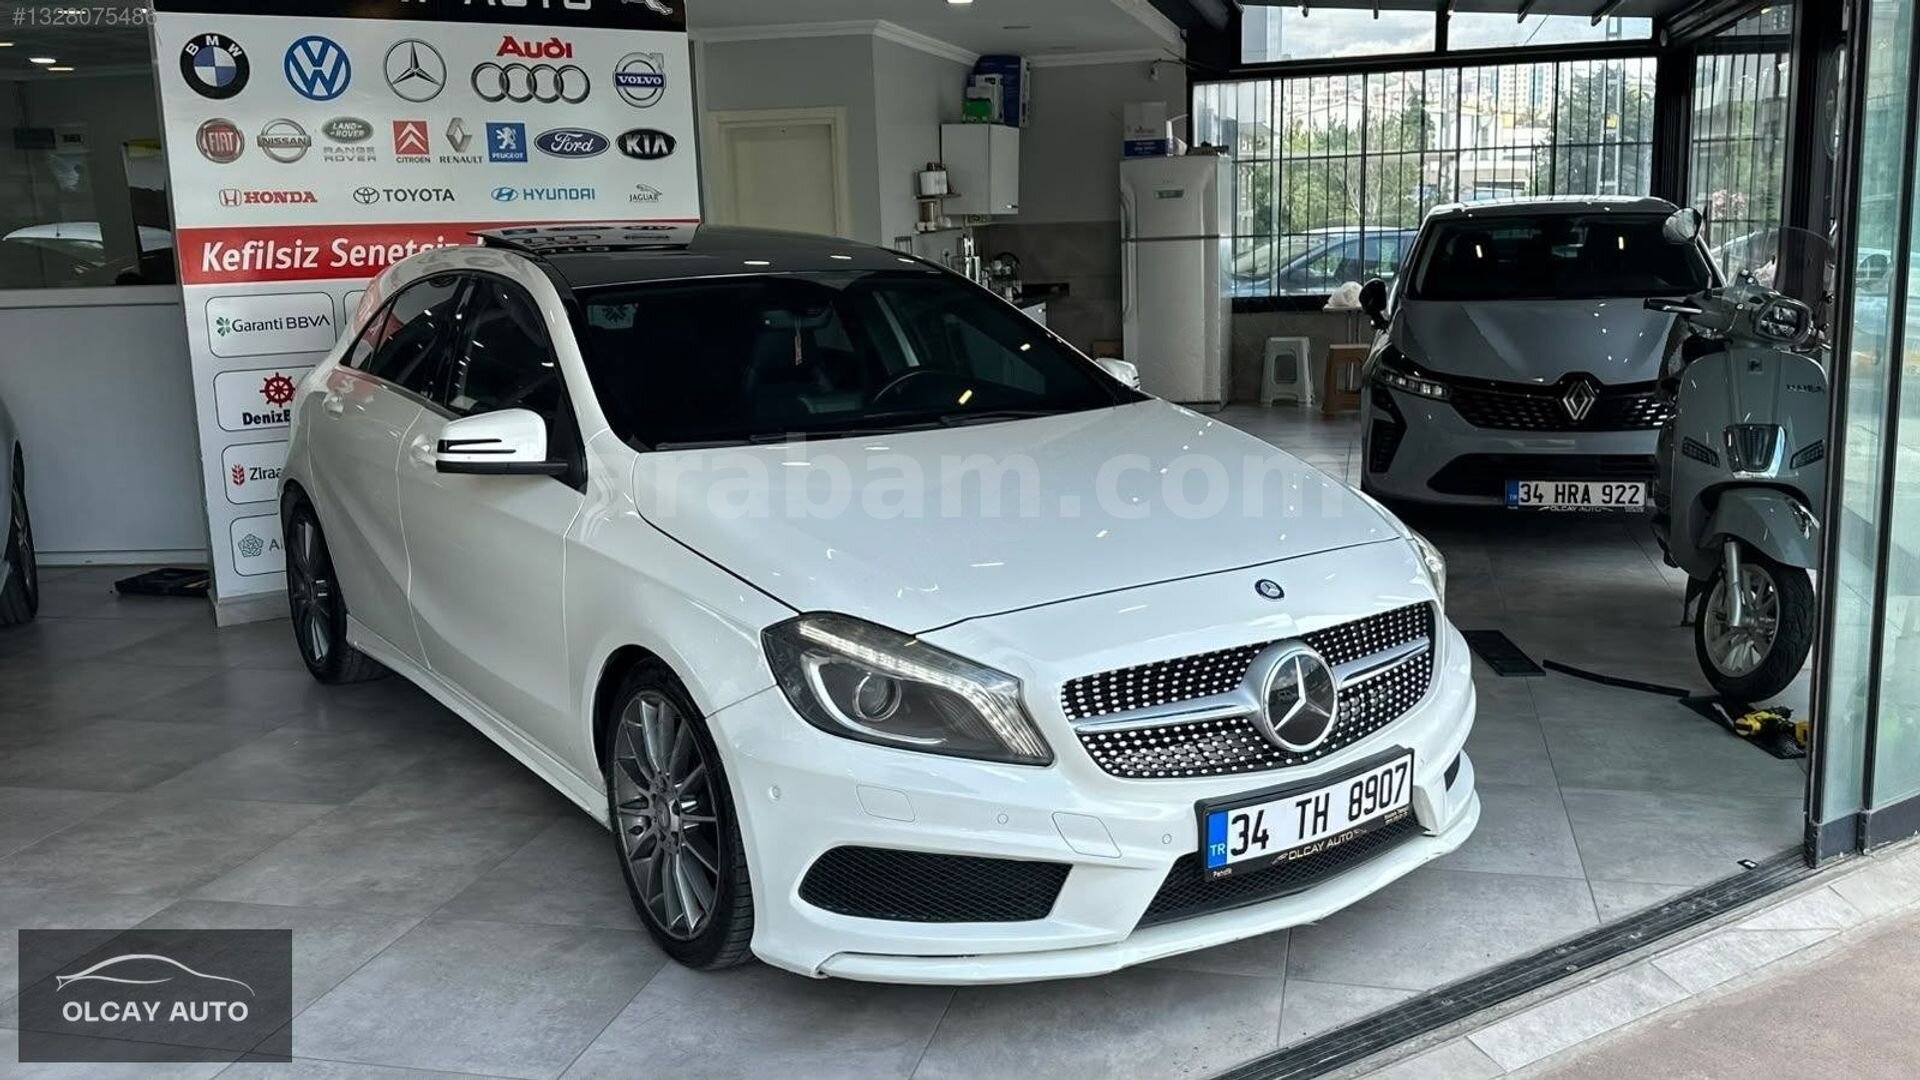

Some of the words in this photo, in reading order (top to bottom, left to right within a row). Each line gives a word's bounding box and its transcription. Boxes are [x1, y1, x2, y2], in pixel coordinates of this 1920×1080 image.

[496, 36, 573, 59] Audi
[617, 74, 662, 85] VOLVO
[208, 131, 234, 148] FIAT
[261, 137, 307, 147] NISSAN
[550, 131, 594, 154] Ford
[625, 134, 669, 155] KIA
[322, 146, 375, 154] RANGE
[491, 152, 524, 160] PEUGEOT
[324, 155, 377, 163] ROVER
[439, 156, 483, 164] RENAULT
[243, 191, 318, 205] HONDA
[383, 188, 455, 202] TOYOTA
[523, 188, 595, 201] HYUNDAI
[629, 193, 659, 203] JAGUAR
[201, 239, 320, 273] Kefilsiz
[330, 236, 460, 268] Senet
[231, 316, 284, 334] Garanti
[286, 314, 331, 330] BBVA
[1519, 483, 1545, 504] 34
[1554, 484, 1593, 505] HRA
[1602, 484, 1641, 506] 922
[1230, 809, 1270, 856] 34
[1295, 792, 1331, 840] TH
[1347, 761, 1409, 822] 8907
[1210, 843, 1226, 857] TR
[1287, 840, 1325, 861] OLCAY
[1325, 830, 1354, 850] AUTO
